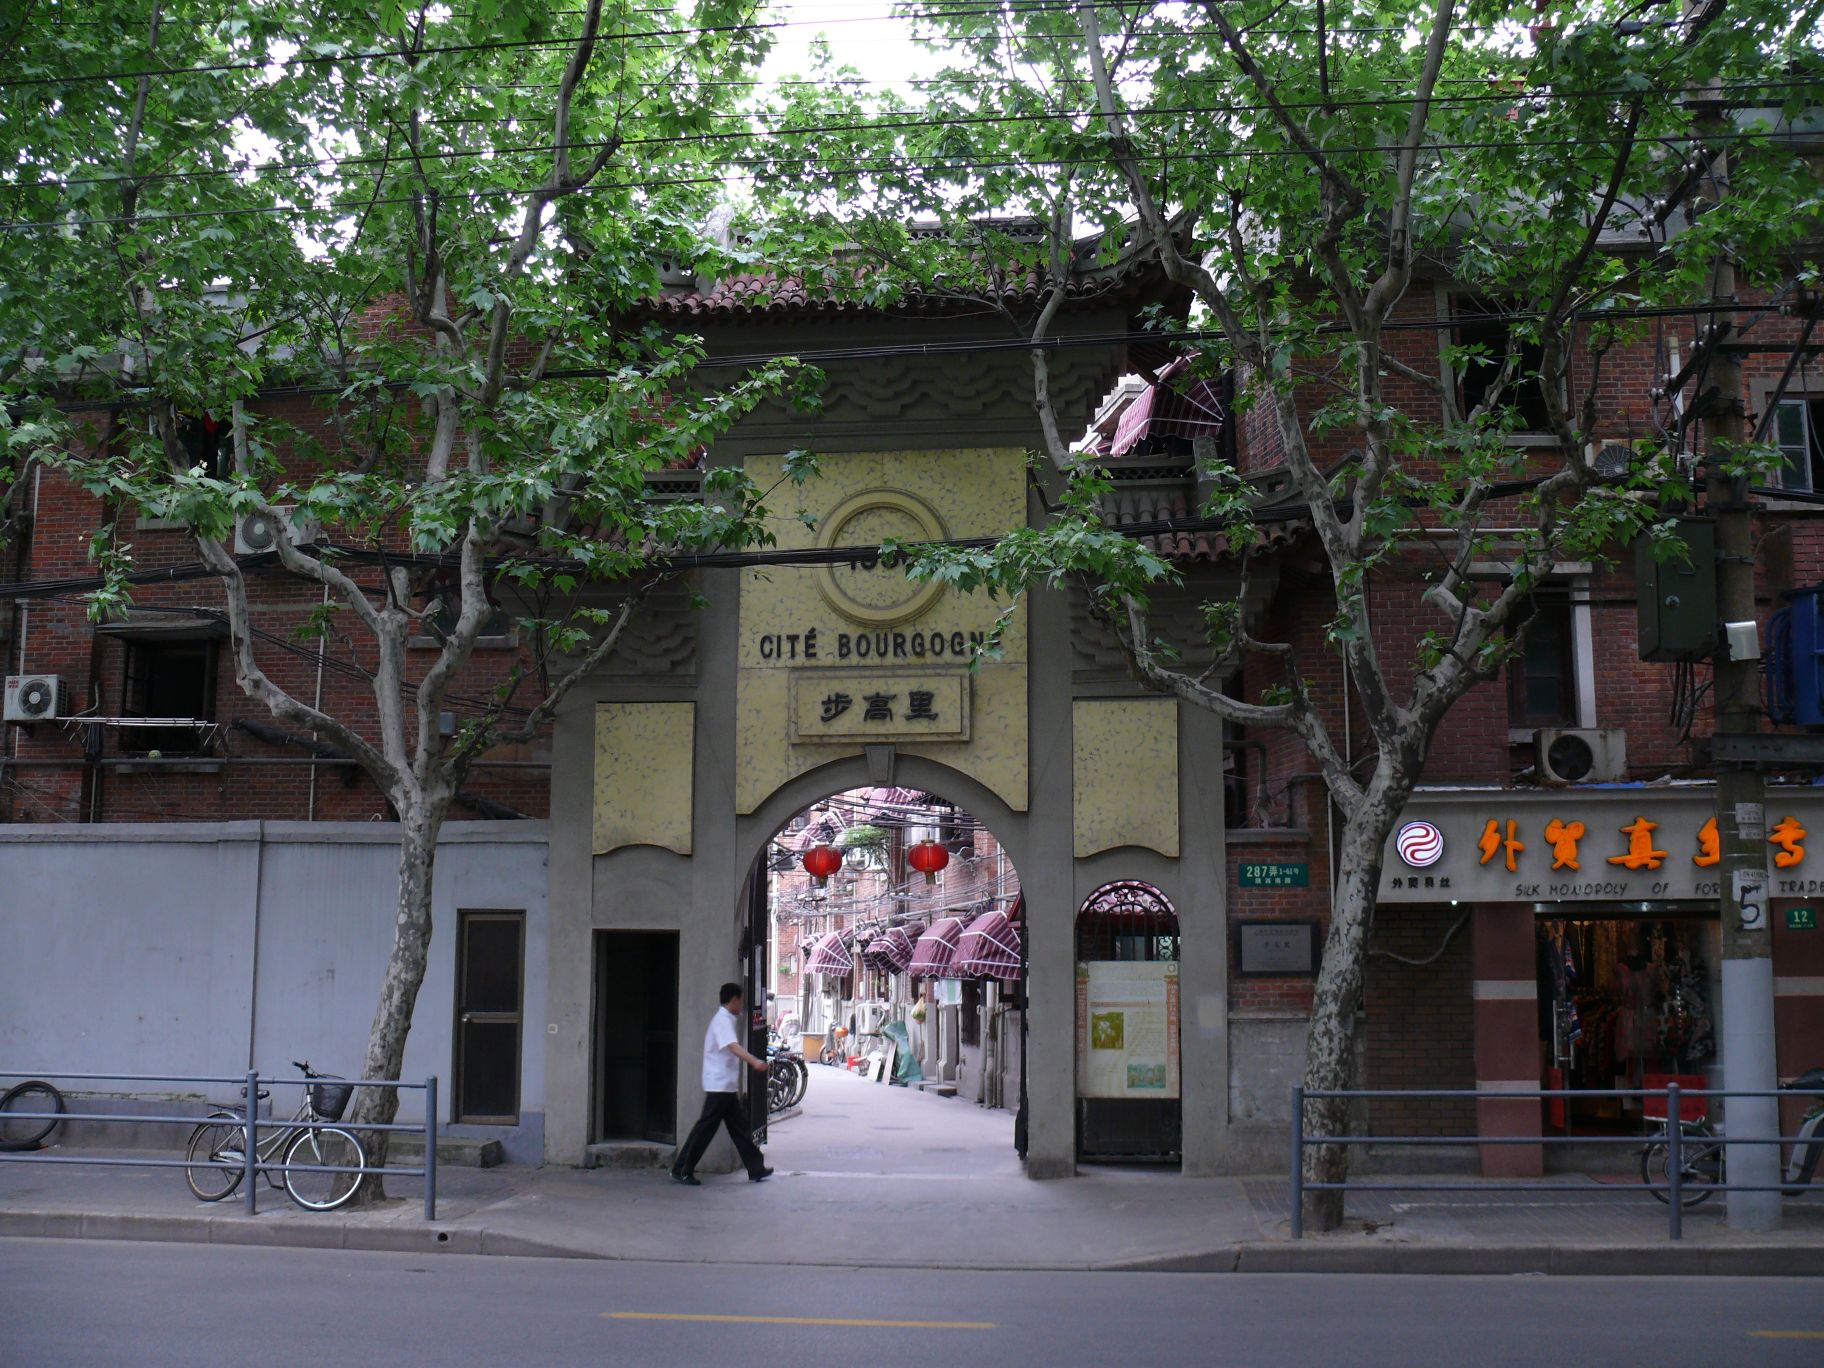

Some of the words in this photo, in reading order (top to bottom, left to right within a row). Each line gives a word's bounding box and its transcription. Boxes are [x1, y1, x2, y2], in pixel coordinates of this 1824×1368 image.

[760, 627, 818, 659] CITÉ
[838, 630, 1000, 658] BOURGOGN
[820, 691, 939, 722] 步高里
[1515, 883, 1540, 897] SILK
[1549, 882, 1628, 897] MONOPOLY
[1652, 882, 1669, 895] OF
[1740, 884, 1762, 924] 5
[1794, 911, 1808, 922] 12
